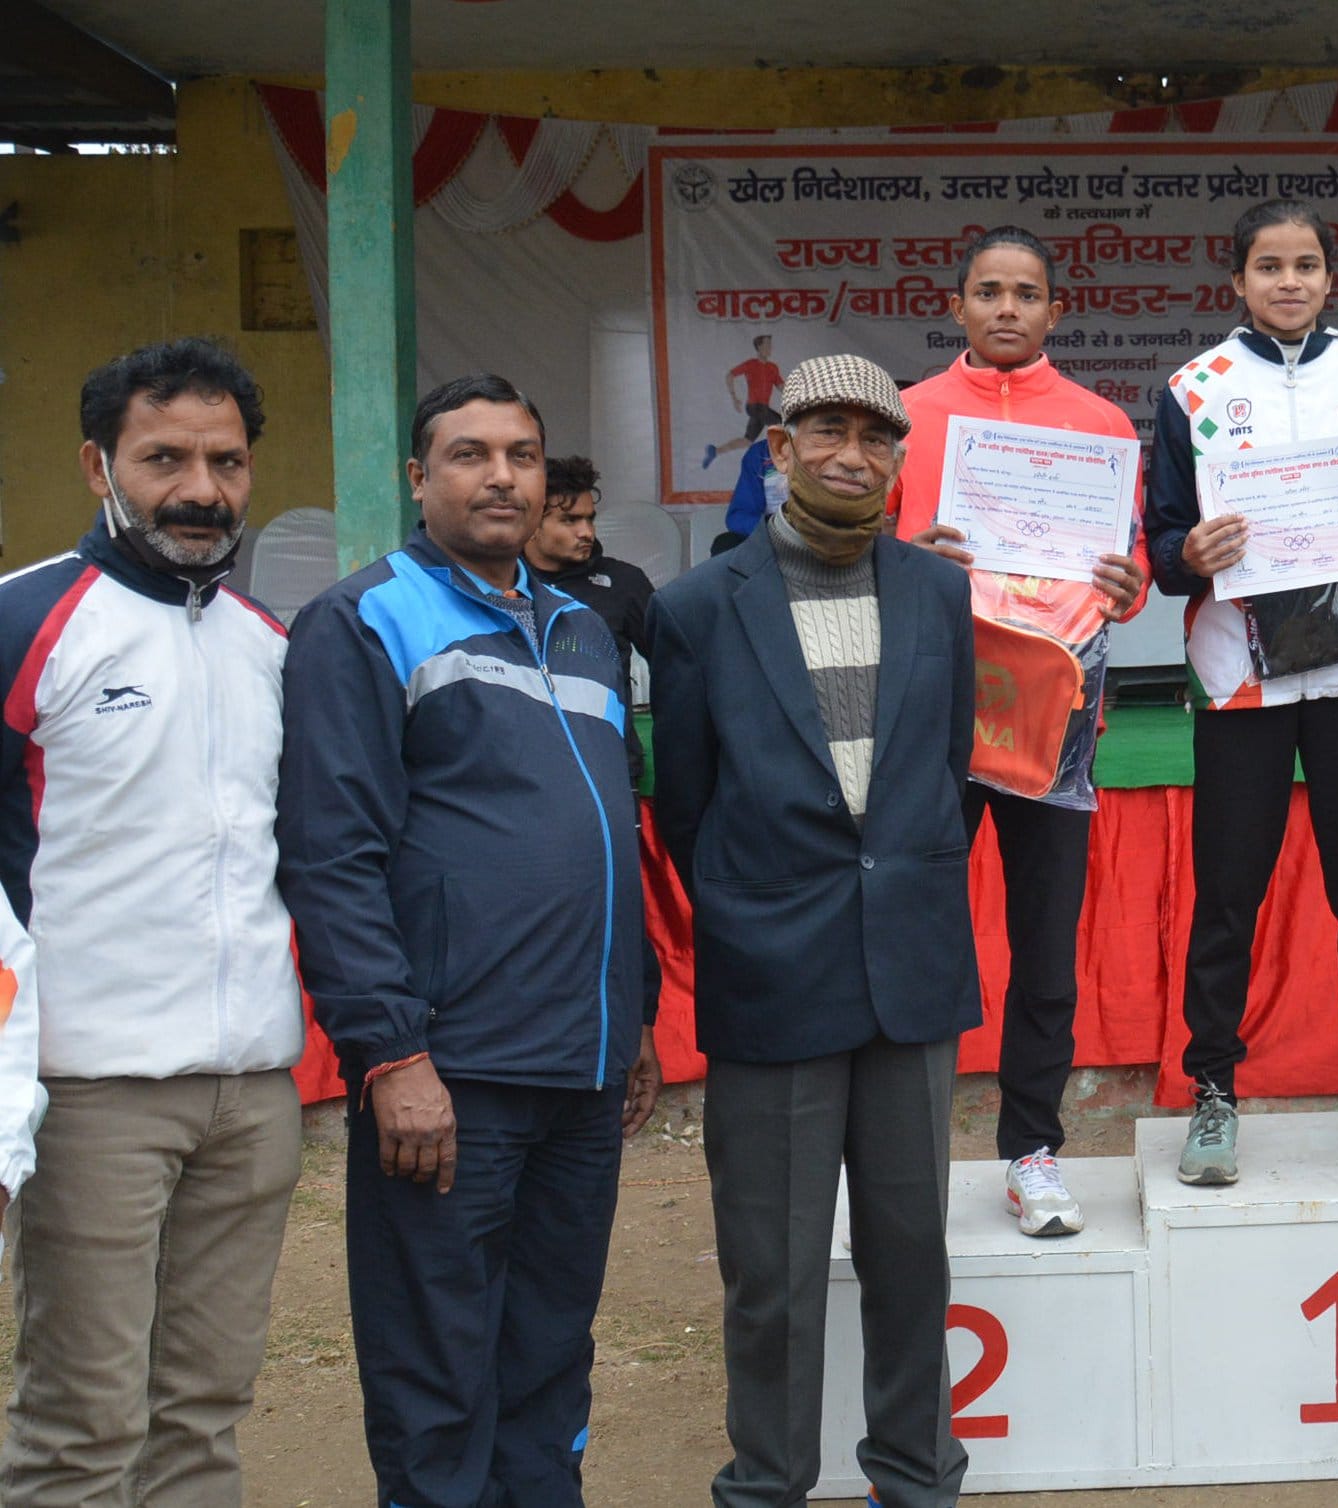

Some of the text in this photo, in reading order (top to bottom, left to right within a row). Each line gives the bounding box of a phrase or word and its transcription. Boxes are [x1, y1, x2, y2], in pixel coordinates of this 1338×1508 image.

[729, 170, 785, 203] खेल
[793, 167, 930, 203] निदेशालय,
[941, 175, 1009, 200] उत्तर
[1016, 166, 1079, 203] प्रदेश
[1087, 165, 1129, 198] एवं
[1132, 173, 1198, 198] उत्तर
[1207, 165, 1268, 201] प्रदेश
[1044, 205, 1061, 219] के
[1132, 203, 1152, 219] में
[776, 238, 881, 268] राज्य
[1228, 426, 1254, 437] VATS
[946, 1303, 1010, 1439] 2
